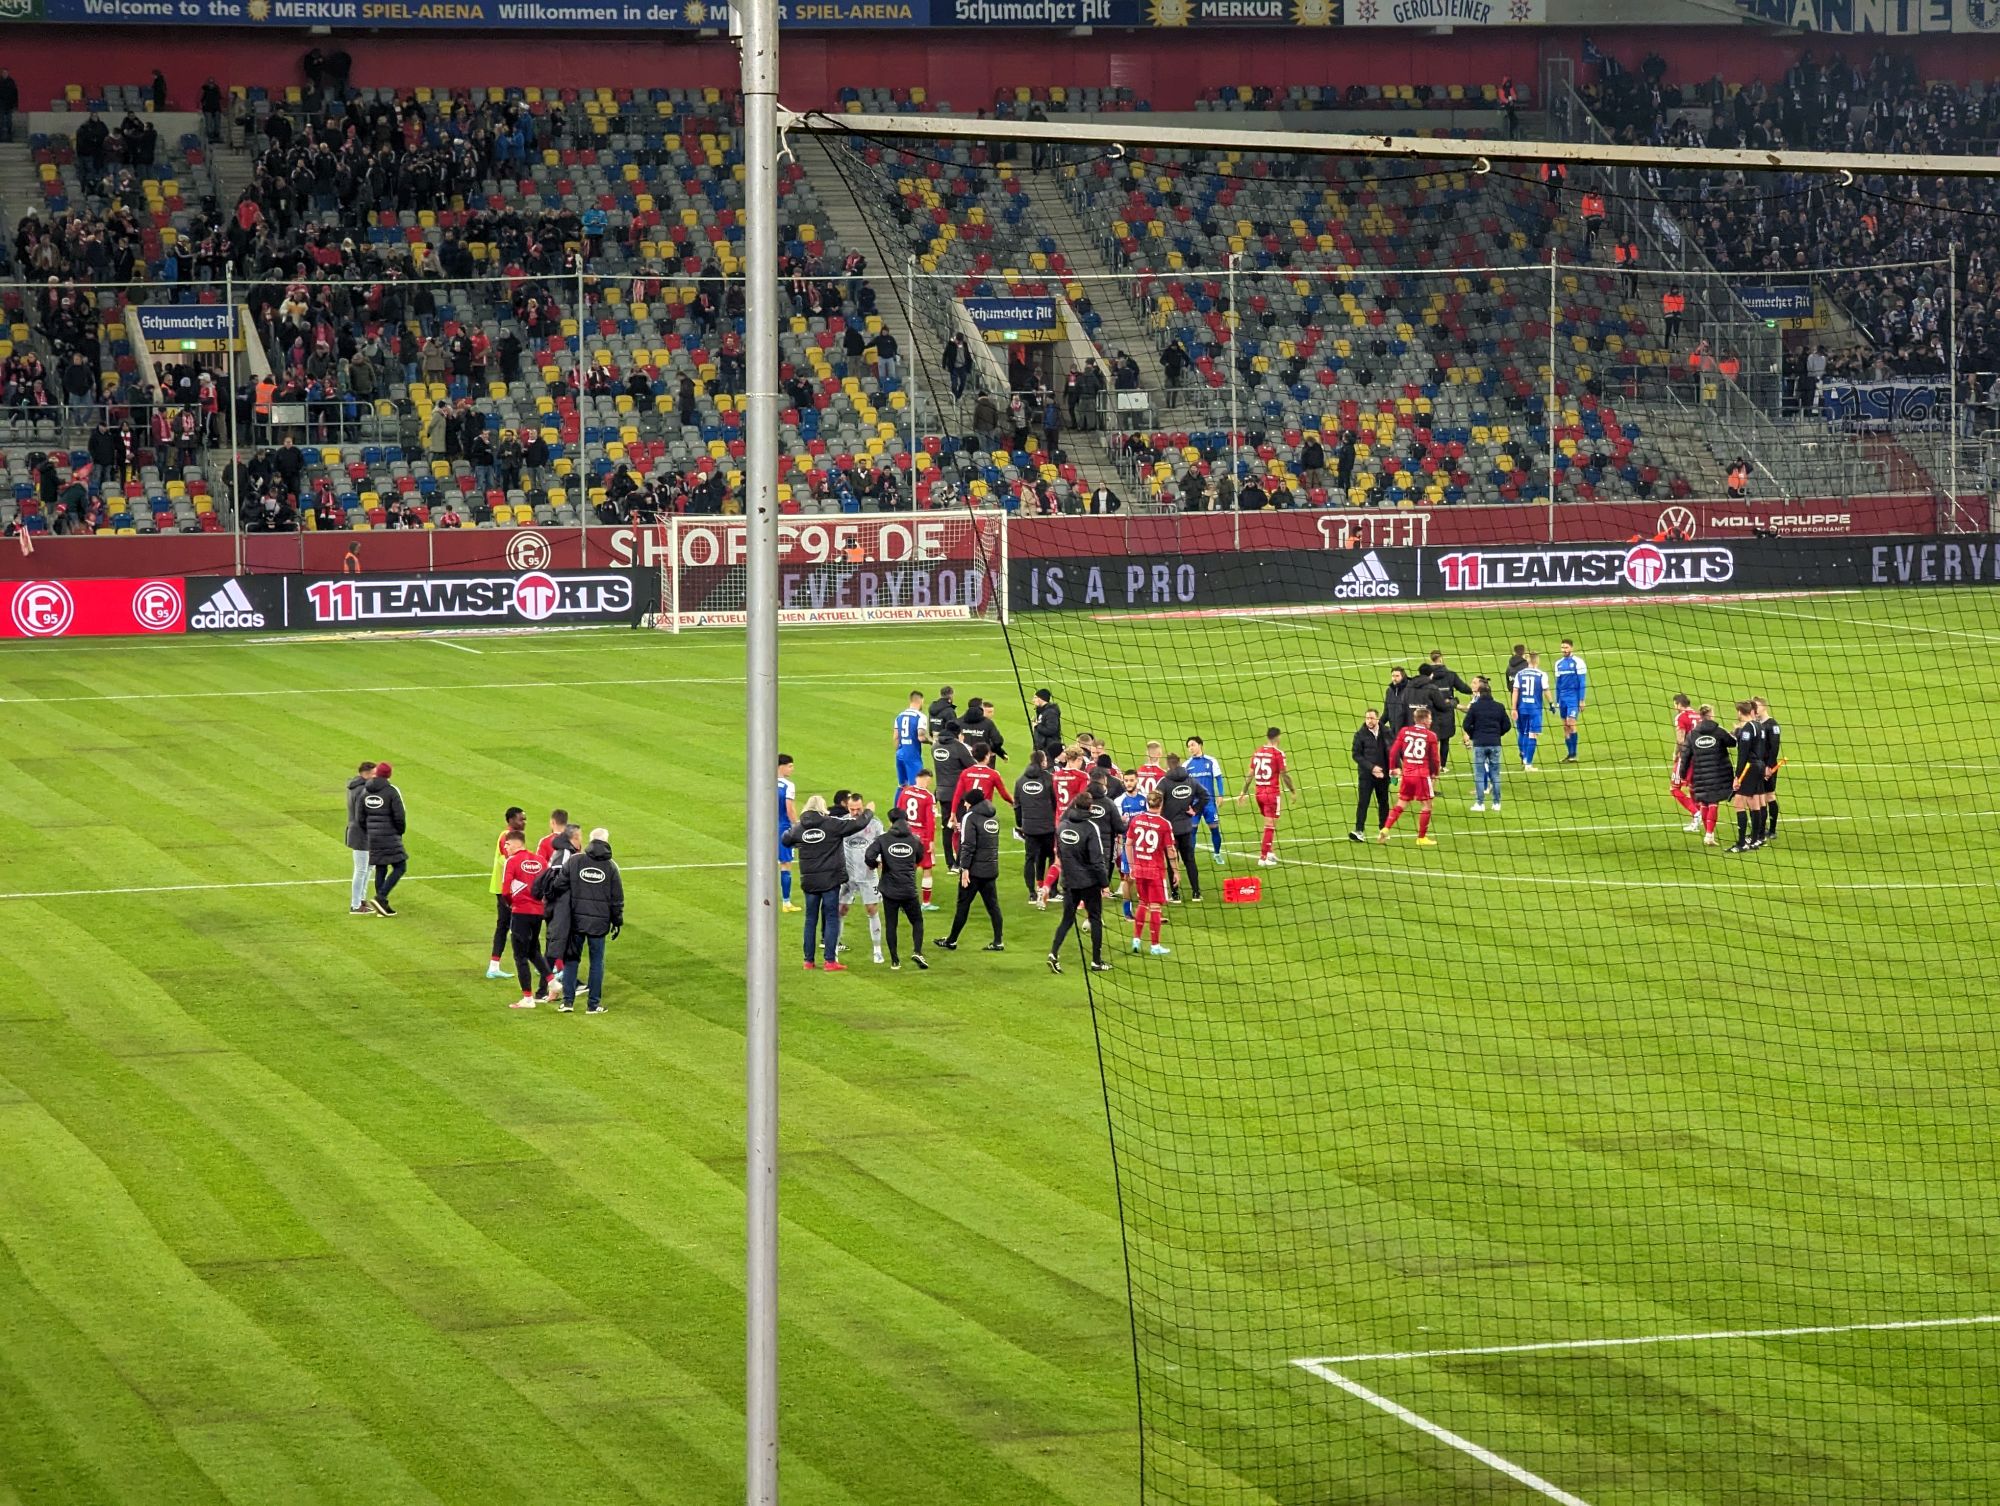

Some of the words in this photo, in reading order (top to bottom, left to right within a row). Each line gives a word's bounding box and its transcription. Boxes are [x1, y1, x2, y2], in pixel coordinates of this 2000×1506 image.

[84, 0, 173, 15] Welcome
[179, 2, 201, 16] to
[208, 1, 241, 17] the
[275, 3, 356, 18] MERKUR
[362, 4, 484, 19] SPIEL-ARENA
[498, 4, 617, 20] Willkommen
[623, 4, 641, 20] in
[646, 5, 678, 20] der
[795, 5, 913, 19] SPIEL-ARENA
[955, 0, 1076, 23] Schumacher
[1082, 0, 1111, 22] Alt
[1201, 2, 1283, 17] MERKUR
[1393, 0, 1490, 24] GEROLSTEINER
[142, 315, 214, 330] Schumacher
[968, 306, 1033, 321] Schumacher
[1036, 306, 1052, 320] Alt
[1791, 318, 1803, 329] 19
[1032, 329, 1045, 341] 17
[151, 339, 165, 351] 14
[213, 339, 226, 351] 15
[1711, 516, 1765, 527] MOLL
[1770, 514, 1851, 526] GRUPPE
[1031, 567, 1064, 606] IS
[1085, 567, 1105, 604] A
[1127, 564, 1196, 604] PRO
[1334, 580, 1399, 598] adidas
[191, 610, 265, 629] adidas
[810, 611, 858, 622] AKTUELL
[867, 609, 912, 621] KÜCHEN
[917, 608, 965, 619] AKTUELL
[1521, 675, 1535, 696] 31
[901, 716, 910, 738] 9
[1404, 735, 1426, 759] 28
[1253, 757, 1272, 780] 25
[1057, 781, 1070, 804] 5
[906, 797, 918, 820] 8
[1134, 827, 1159, 853] 29
